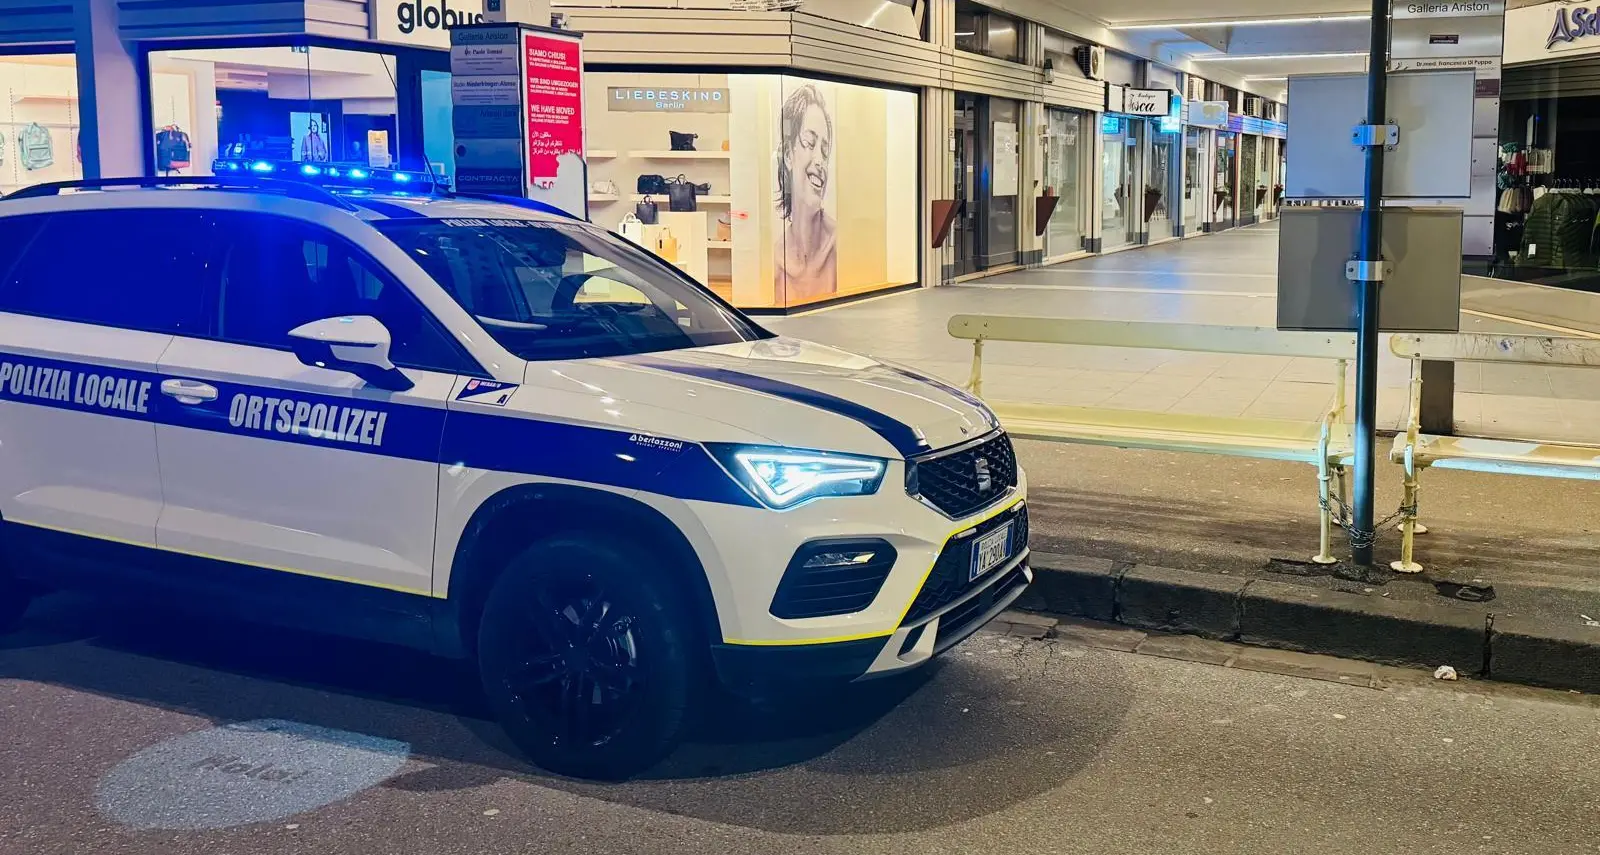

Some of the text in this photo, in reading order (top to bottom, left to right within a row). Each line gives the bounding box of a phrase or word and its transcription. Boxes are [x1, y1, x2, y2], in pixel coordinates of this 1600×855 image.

[1408, 2, 1489, 13] Galleria Ariston
[615, 90, 721, 101] LIEBESKIND
[531, 104, 540, 112] WE
[655, 101, 684, 109] Berlin
[0, 362, 152, 413] POLIZIA LOCALE
[496, 394, 507, 404] A
[228, 393, 388, 446] ORTSPOLIZEI
